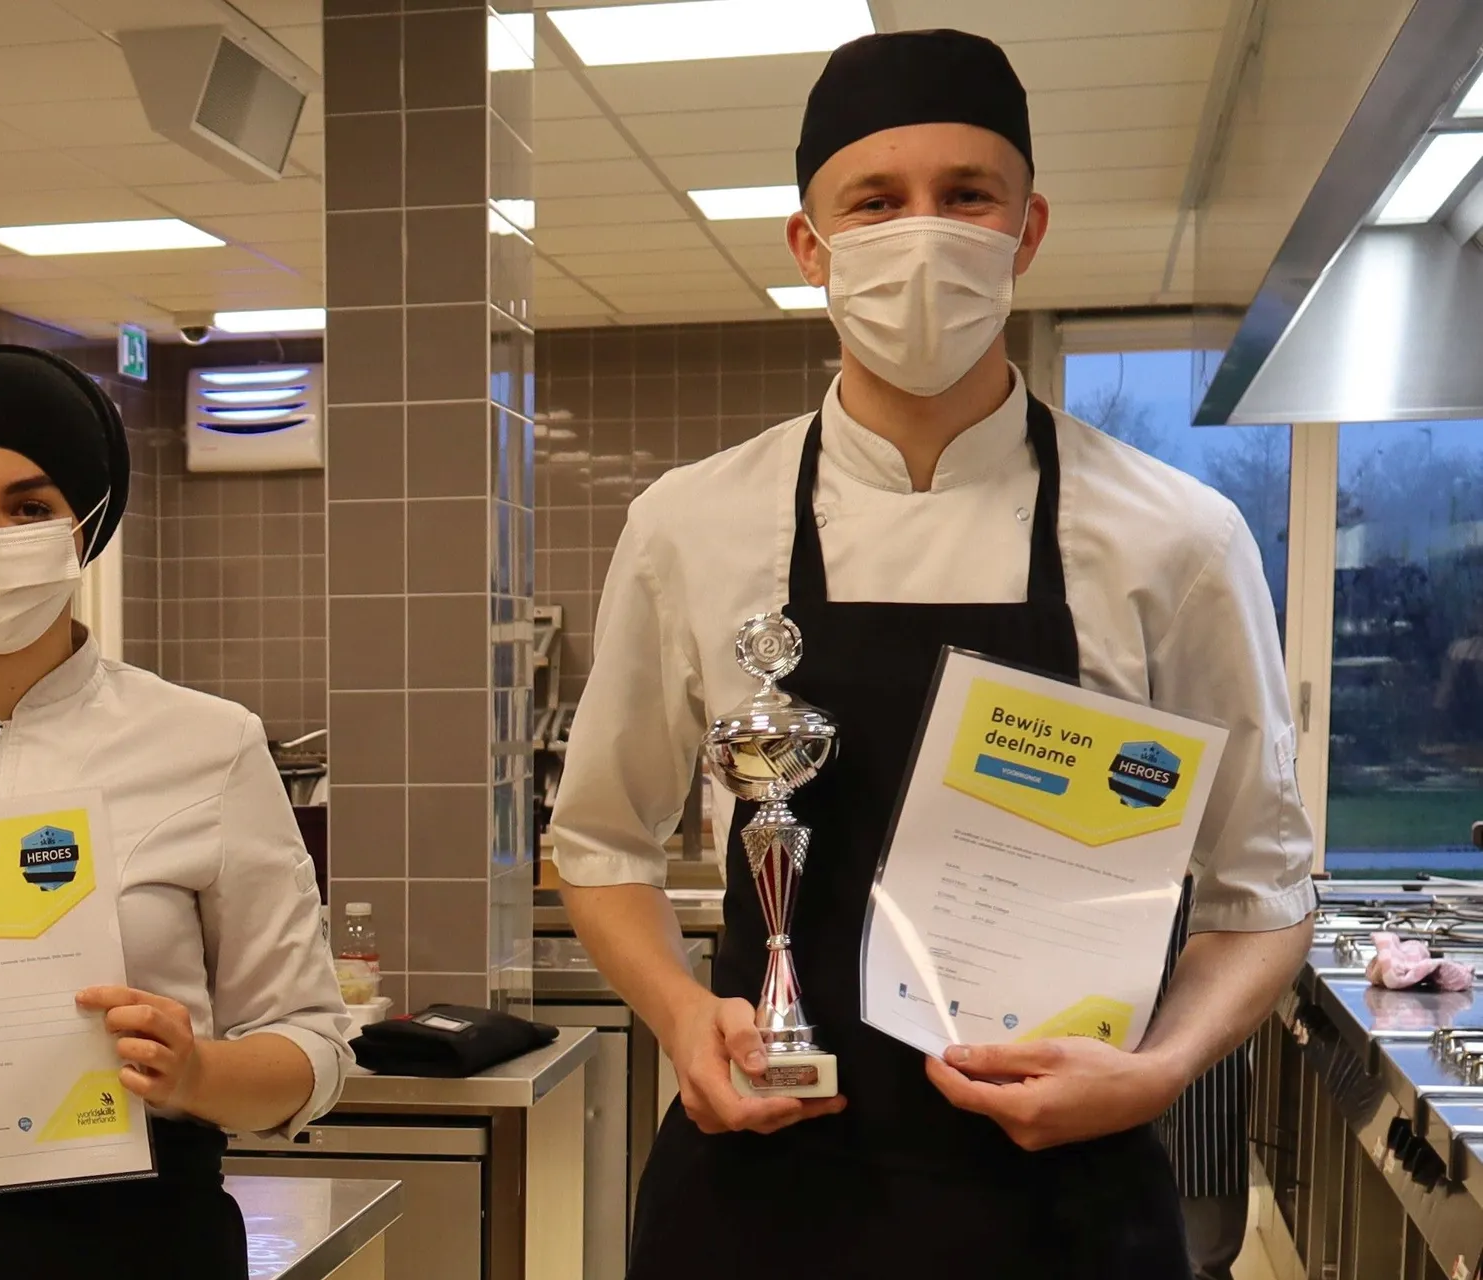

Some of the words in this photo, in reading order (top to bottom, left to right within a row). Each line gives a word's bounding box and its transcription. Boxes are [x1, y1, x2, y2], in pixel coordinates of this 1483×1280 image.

[764, 639, 774, 654] 2
[991, 706, 1052, 738] Bewijs
[1061, 728, 1093, 749] van
[984, 729, 1077, 767] deelname
[1118, 760, 1170, 784] HEROES
[27, 848, 72, 863] HEROES
